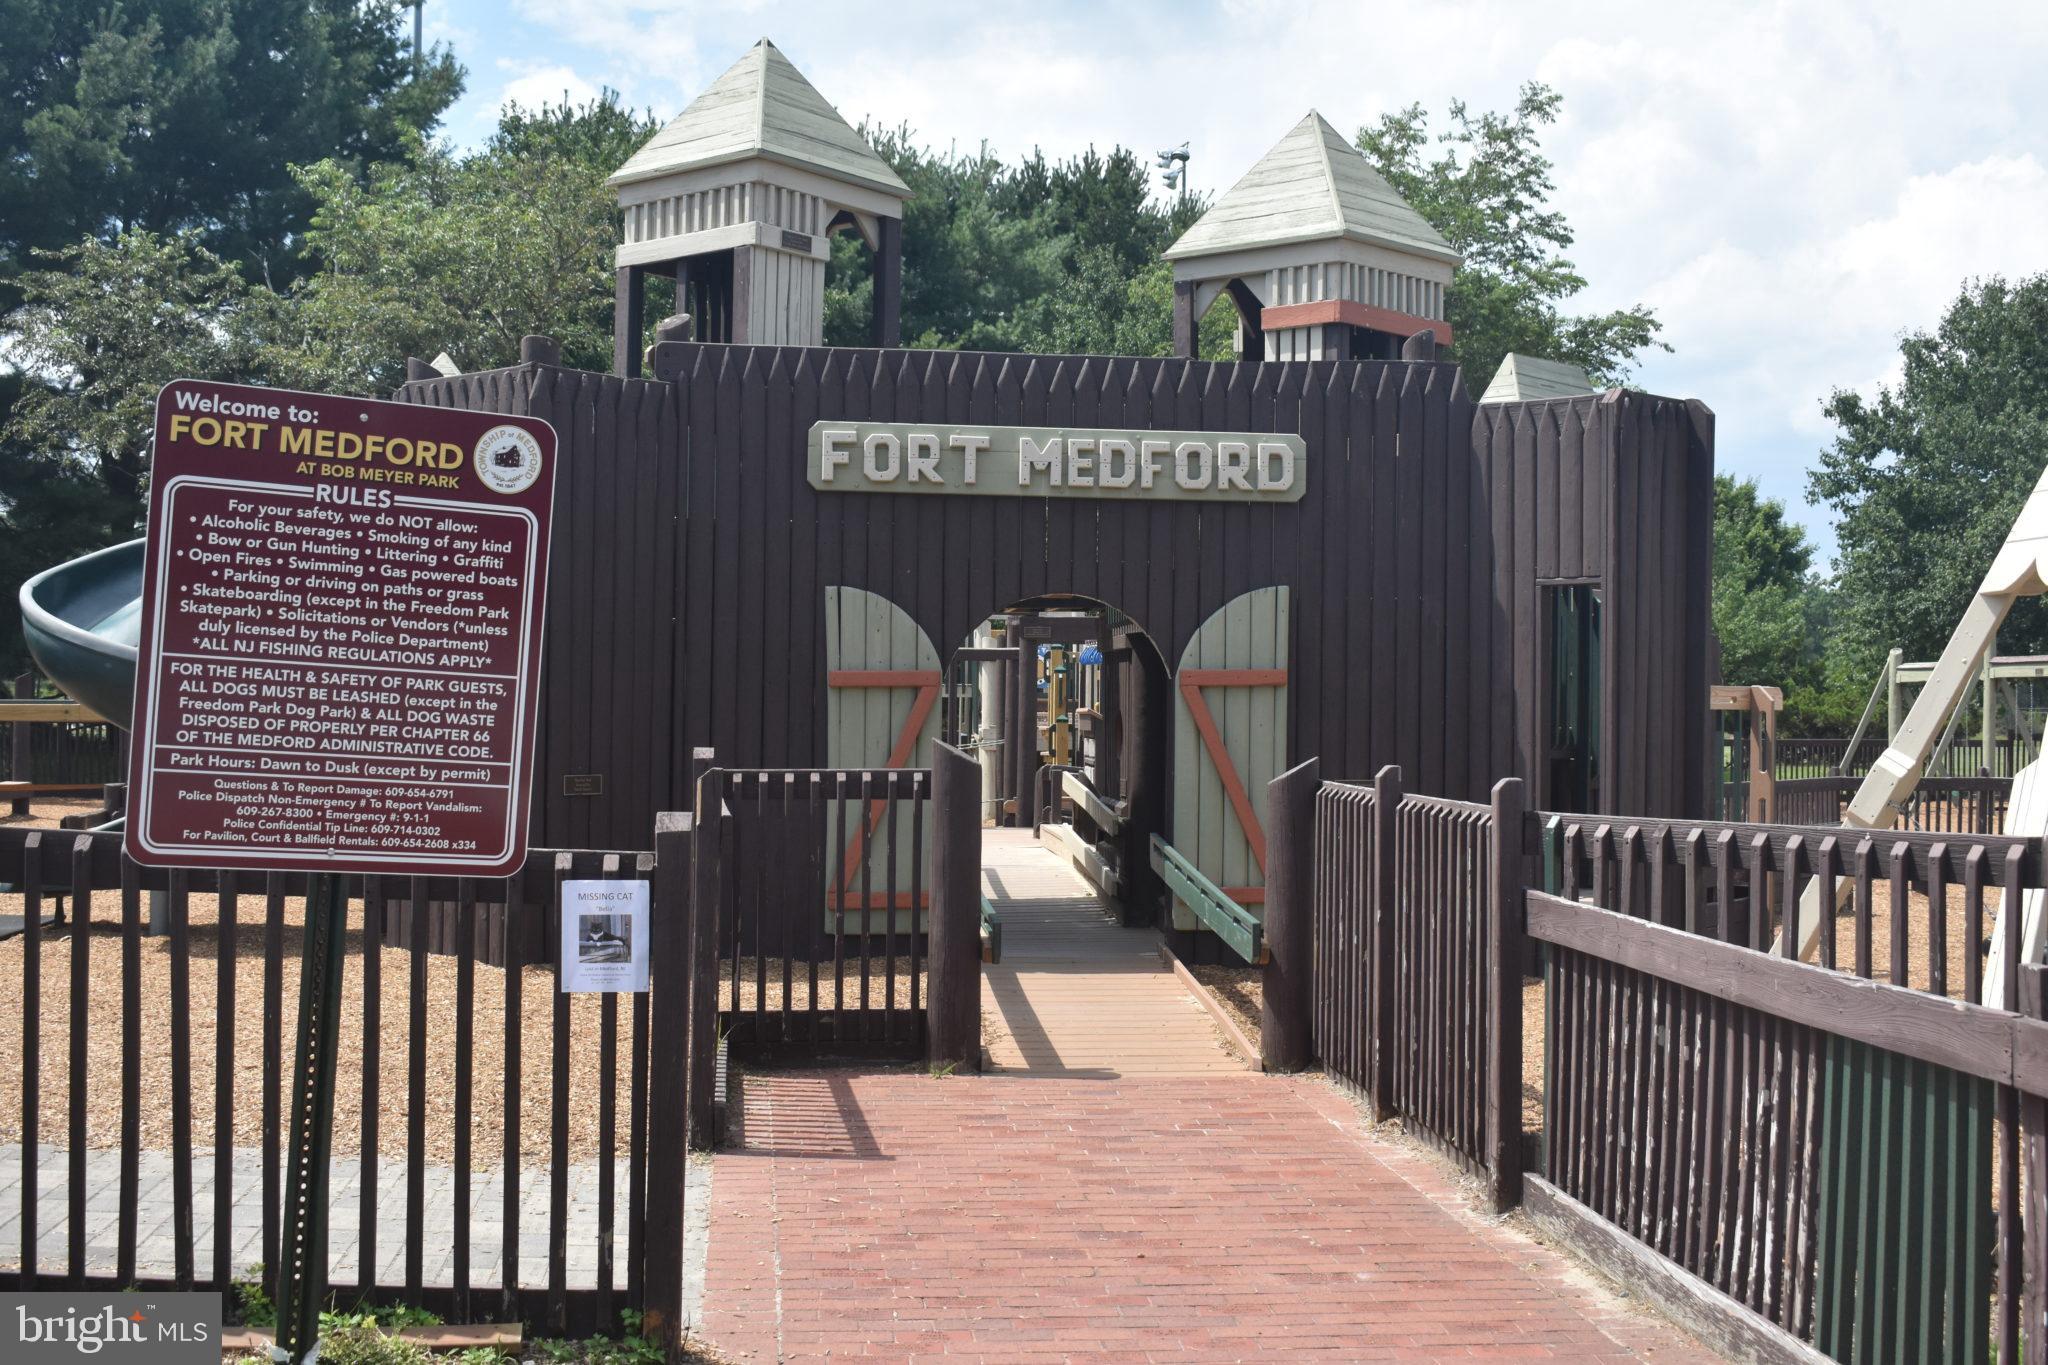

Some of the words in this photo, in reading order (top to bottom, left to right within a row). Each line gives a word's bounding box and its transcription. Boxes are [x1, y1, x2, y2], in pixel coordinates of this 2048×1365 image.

[175, 390, 281, 420] Welcome
[287, 405, 319, 424] to:
[169, 414, 269, 450] FORT
[279, 425, 464, 470] MEDFORD
[478, 430, 506, 476] TOWNSHIP
[516, 433, 537, 479] MEDFORD
[296, 461, 317, 475] AT
[321, 463, 355, 479] BOB
[359, 467, 415, 485] MEYER
[418, 473, 460, 489] PARK
[822, 430, 990, 484] FORT
[1018, 437, 1295, 491] MEDFORD
[316, 483, 392, 509] RULES
[228, 499, 255, 513] For
[258, 505, 293, 518] your
[296, 506, 344, 525] safety,
[349, 513, 371, 524] we
[375, 512, 395, 526] do
[399, 515, 433, 530] NOT
[436, 518, 478, 534] allow:
[201, 514, 271, 532] Alcoholic
[274, 520, 352, 541] Beverages
[368, 529, 430, 550] Smoking
[433, 535, 450, 548] of
[452, 540, 478, 554] any
[482, 538, 512, 553] kind
[208, 532, 242, 547] Bow
[245, 538, 263, 548] or
[266, 537, 297, 552] Gun
[301, 540, 360, 561] Hunting
[376, 546, 438, 567] Littering
[453, 553, 504, 569] Graffiti
[188, 548, 231, 565] Open
[235, 551, 272, 567] Fires
[288, 556, 364, 578] Swimming
[380, 564, 408, 578] Gas
[411, 570, 475, 584] powered
[479, 571, 518, 587] boats
[223, 568, 280, 588] Parking
[284, 576, 302, 586] or
[305, 574, 357, 594] driving
[361, 582, 379, 593] on
[383, 582, 423, 597] paths
[427, 588, 443, 598] or
[446, 589, 484, 602] grass
[179, 599, 262, 620] Skatepark)
[278, 607, 367, 626] Solicitations
[370, 617, 387, 627] or
[391, 615, 449, 632] Vendors
[192, 583, 302, 607] Skateboarding
[306, 592, 362, 611] (except
[365, 596, 378, 610] in
[382, 598, 407, 612] the
[410, 600, 474, 617] Freedom
[478, 605, 509, 620] Park
[198, 618, 231, 636] duly
[235, 620, 296, 638] licensed
[300, 625, 319, 643] by
[322, 627, 347, 641] the
[351, 629, 395, 645] Police
[398, 633, 489, 653] Department)
[233, 639, 255, 653] NJ
[259, 641, 323, 658] FISHING
[327, 646, 435, 666] REGULATIONS
[170, 662, 203, 676] FOR
[207, 664, 238, 678] THE
[242, 666, 301, 682] HEALTH
[305, 670, 317, 683] &
[321, 671, 378, 687] SAFETY
[380, 675, 403, 689] OF
[406, 677, 445, 692] PARK
[448, 680, 507, 697] GUESTS,
[179, 679, 208, 693] ALL
[212, 681, 258, 696] DOGS
[261, 684, 306, 699] MUST
[309, 687, 328, 701] BE
[332, 689, 401, 705] LEASHED
[404, 693, 456, 711] (except
[459, 697, 472, 709] in
[475, 697, 498, 711] the
[179, 696, 245, 712] Freedom
[249, 700, 282, 714] Park
[285, 702, 316, 720] Dog
[320, 704, 357, 721] Park)
[360, 707, 372, 720] &
[375, 708, 403, 722] ALL
[407, 710, 441, 724] DOG
[445, 712, 495, 727] WASTE
[182, 713, 260, 729] DISPOSED
[263, 718, 286, 731] OF
[290, 719, 367, 736] PROPERLY
[369, 724, 399, 738] PER
[401, 726, 470, 742] CHAPTER
[473, 730, 490, 743] 66
[175, 730, 199, 743] OF
[202, 731, 233, 745] THE
[237, 733, 316, 749] MEDFORD
[319, 738, 444, 756] ADMINISTRATIVE
[448, 744, 494, 759] CODE.
[170, 752, 204, 766] Park
[208, 754, 256, 769] Hours:
[260, 757, 301, 771] Dawn
[305, 760, 321, 772] to
[325, 760, 360, 774] Dusk
[363, 762, 416, 779] (except
[419, 765, 438, 781] by
[441, 768, 491, 782] permit)
[178, 790, 213, 801] Police
[215, 791, 265, 805] Dispatch
[268, 794, 357, 810] Non-Emergency
[359, 798, 366, 808] #
[369, 798, 382, 809] To
[385, 799, 423, 812] Report
[425, 801, 482, 813] Vandalism:
[214, 778, 268, 791] Questions
[270, 781, 280, 791] &
[282, 781, 295, 792] To
[297, 782, 334, 795] Report
[336, 784, 383, 798] Damage:
[384, 786, 454, 799] 609-654-6791
[223, 817, 255, 829] Police
[257, 819, 322, 831] Confidential
[324, 822, 341, 834] Tip
[343, 823, 368, 833] Line:
[370, 824, 441, 836] 609-714-0302
[236, 805, 314, 818] 609-267-8300
[325, 809, 387, 824] Emergency
[390, 812, 400, 822] #:
[403, 812, 429, 823] 9-1-1
[183, 829, 202, 840] For
[204, 830, 248, 843] Pavilion,
[250, 831, 281, 843] Court
[283, 833, 292, 843] &
[295, 833, 336, 845] Ballfield
[338, 835, 379, 846] Rentals:
[381, 837, 450, 849] 609-654-2608
[451, 840, 476, 850] x334
[578, 892, 615, 901] MISSING
[616, 892, 633, 901] CAT
